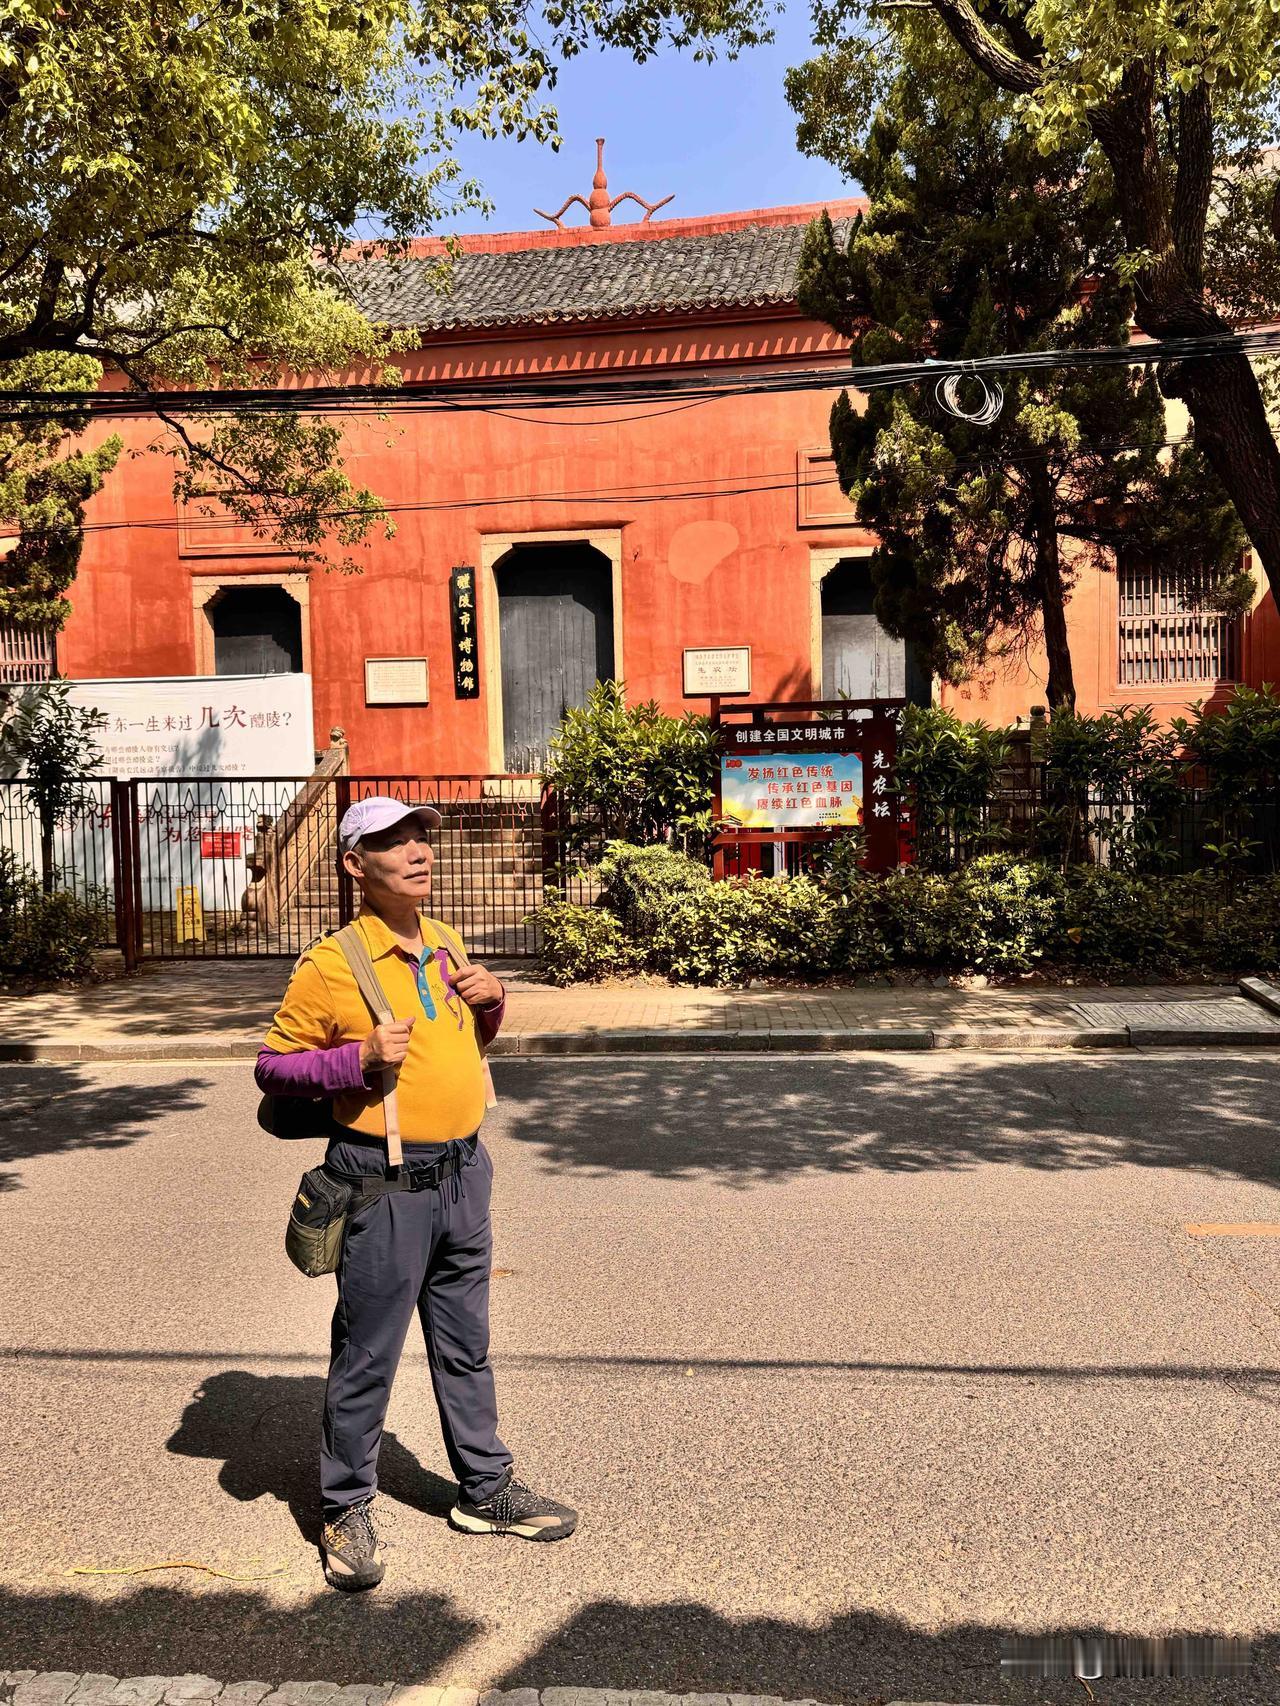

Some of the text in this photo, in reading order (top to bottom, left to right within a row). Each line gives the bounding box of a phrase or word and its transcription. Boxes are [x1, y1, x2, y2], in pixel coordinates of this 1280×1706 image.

[735, 726, 846, 743] 创建全国文明城市
[748, 765, 833, 780] 发扬红色传统
[767, 780, 853, 794] 传承红色基因
[872, 750, 891, 818] 先农坛
[756, 796, 843, 810] 赓续红色血脉
